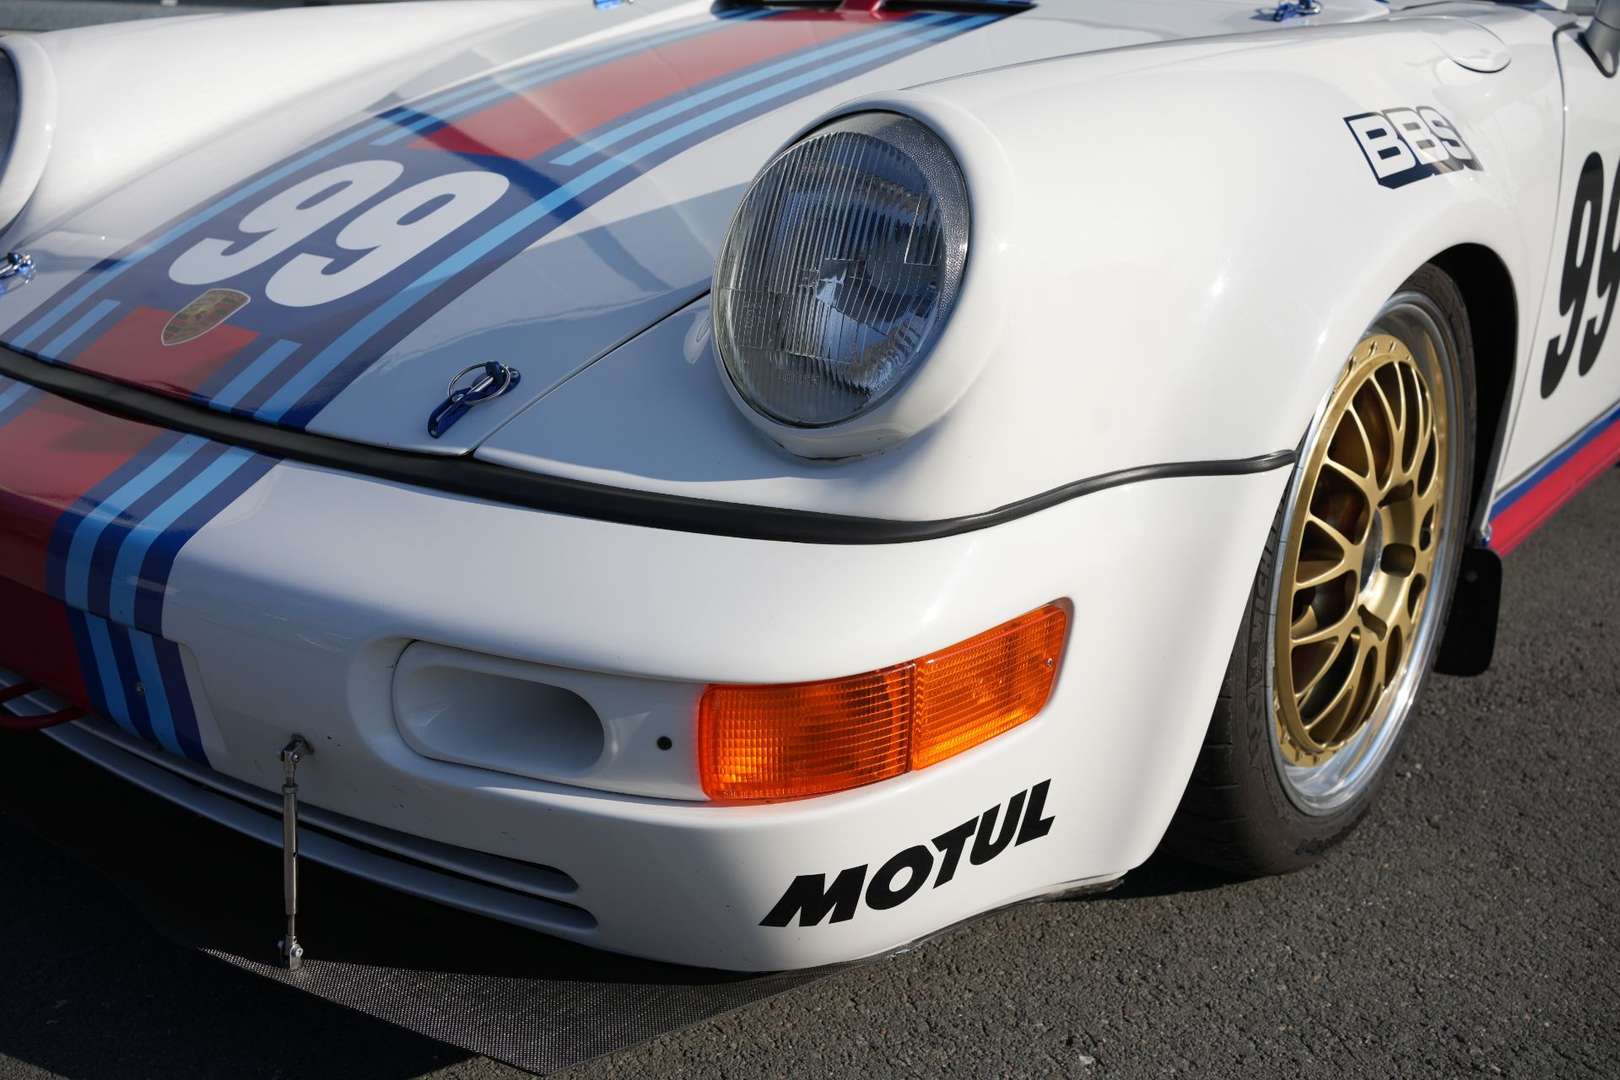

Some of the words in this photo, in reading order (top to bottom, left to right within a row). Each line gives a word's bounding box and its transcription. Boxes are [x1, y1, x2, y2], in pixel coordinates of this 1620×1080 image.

[1343, 105, 1484, 189] BBS
[168, 159, 510, 307] 99
[758, 778, 1056, 928] MOTUL
